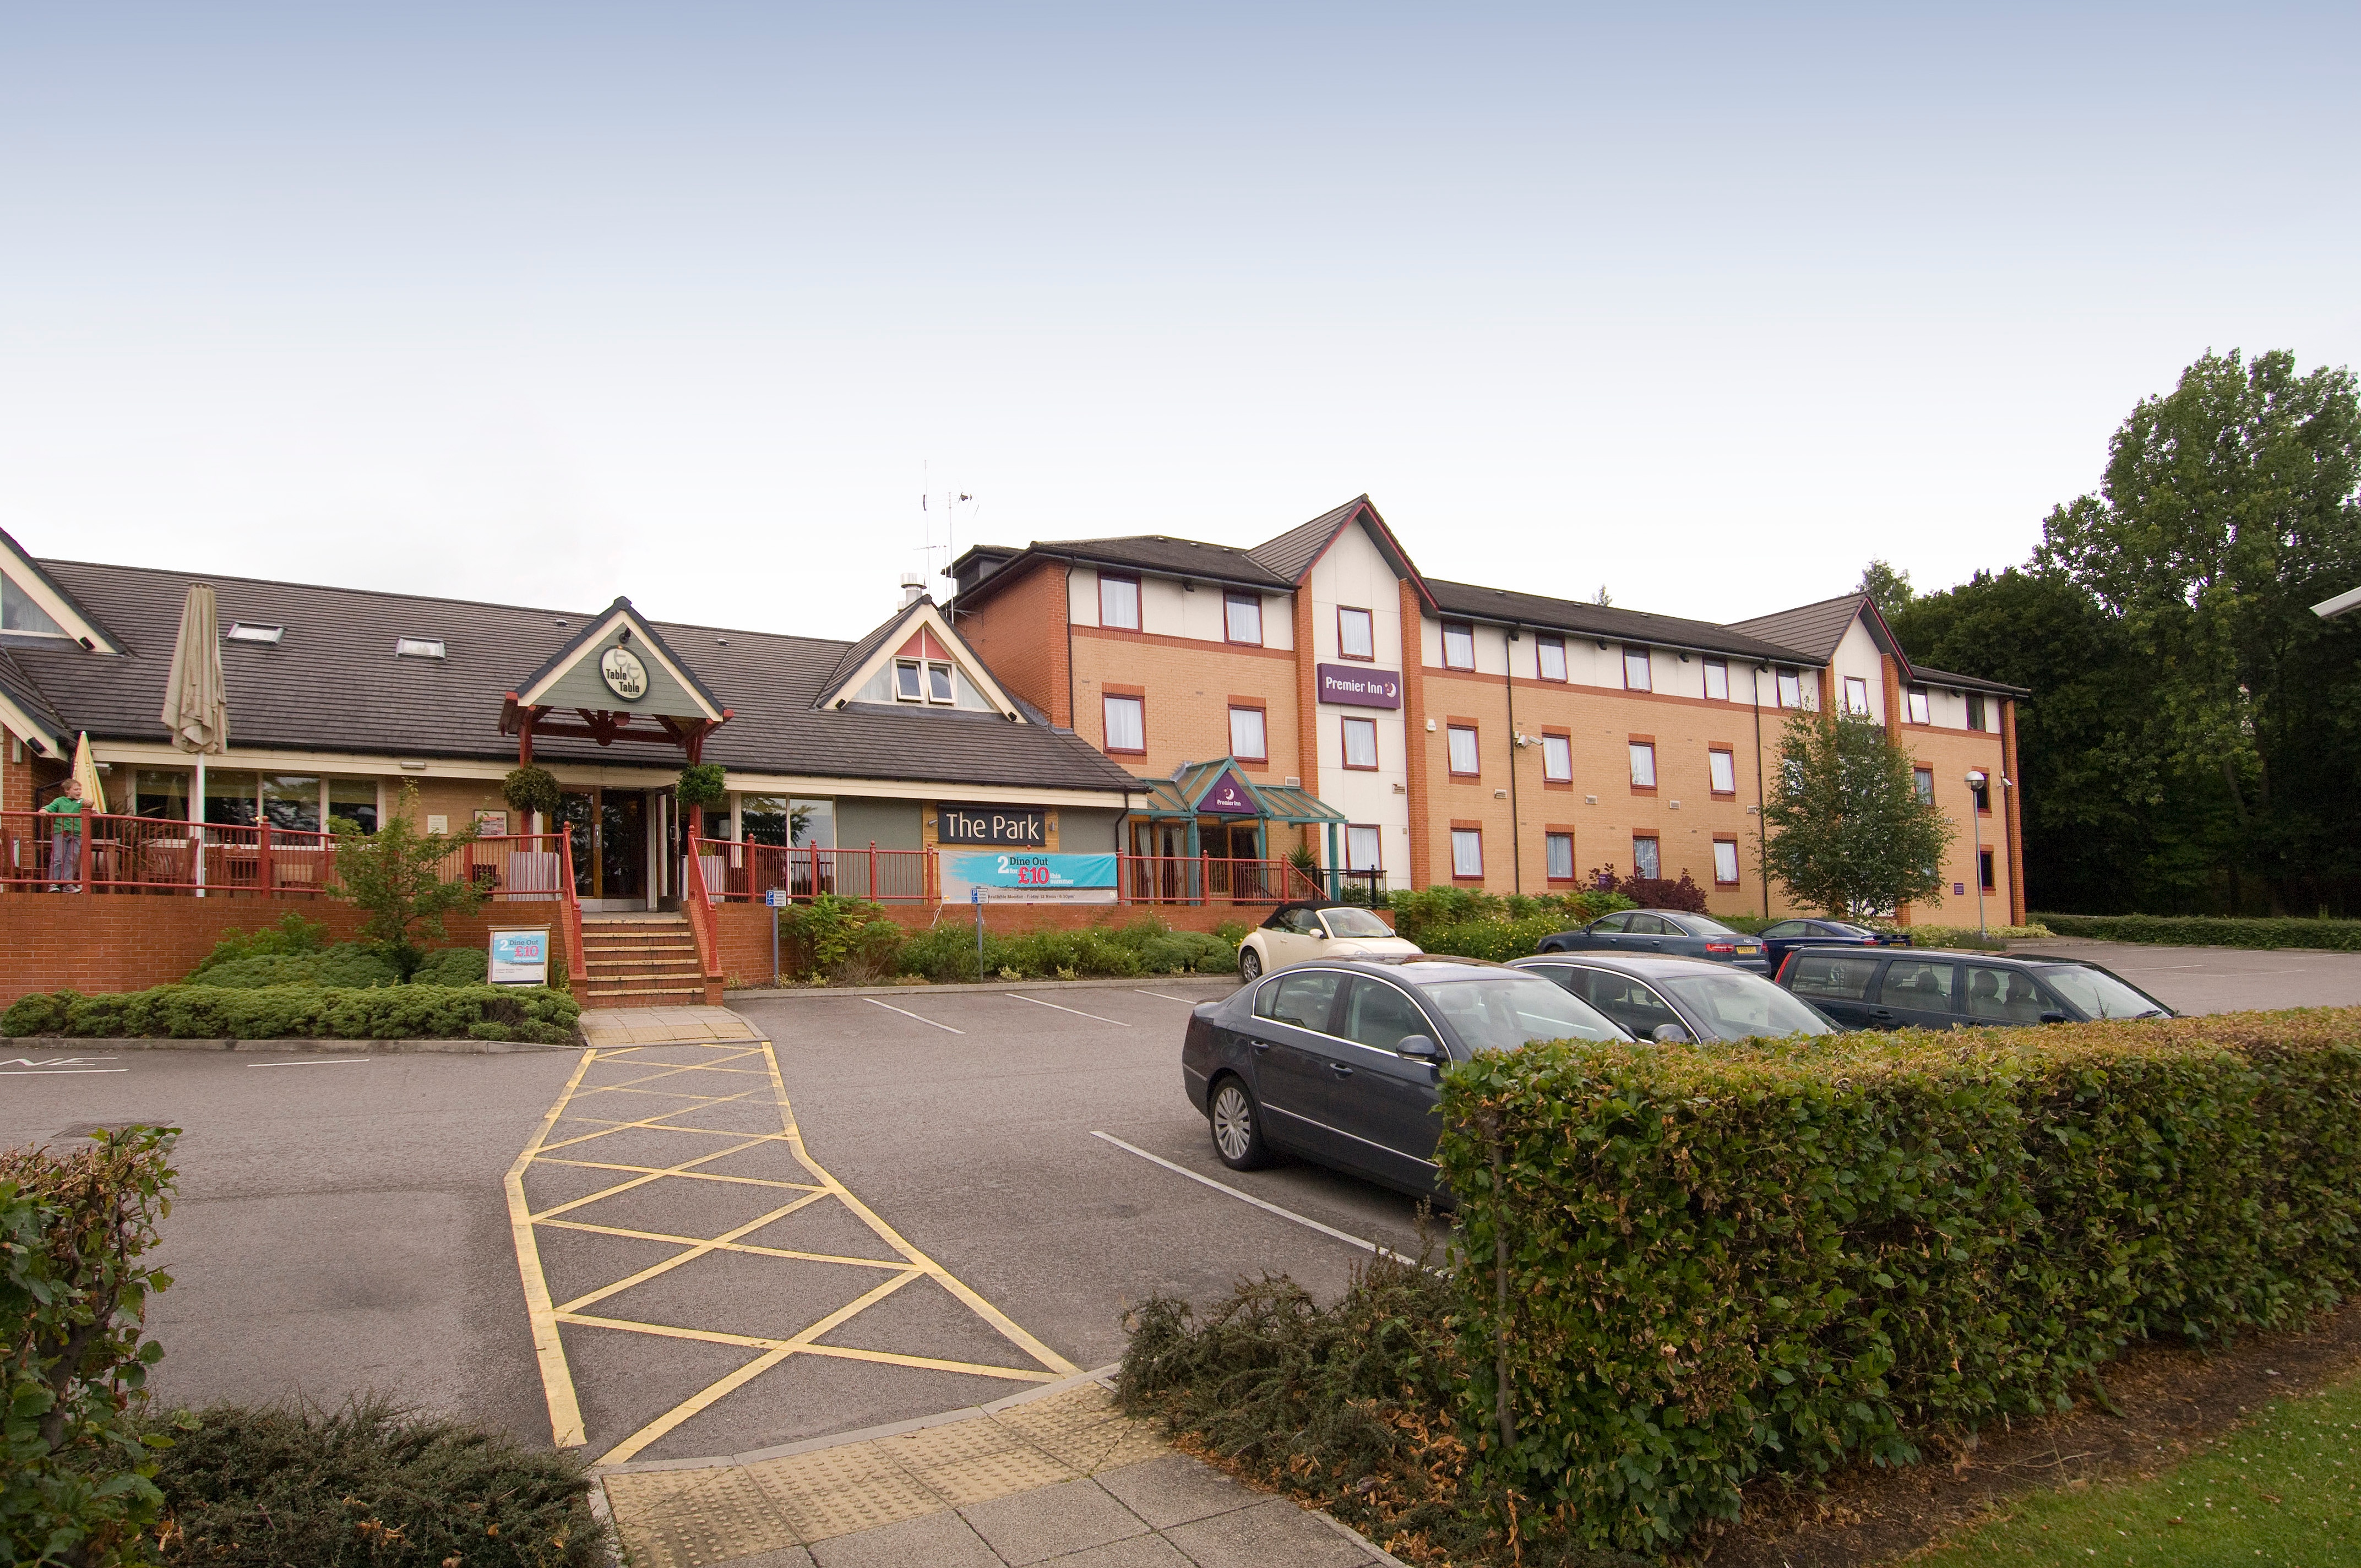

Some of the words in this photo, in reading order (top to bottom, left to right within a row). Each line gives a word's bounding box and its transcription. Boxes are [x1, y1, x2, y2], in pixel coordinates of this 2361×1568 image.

[606, 667, 627, 680] Table
[619, 679, 639, 693] Table
[1326, 676, 1365, 693] Premier
[1368, 681, 1383, 694] Inn
[946, 812, 986, 838] The
[993, 814, 1039, 840] Park
[998, 856, 1009, 874] 2
[1010, 857, 1030, 865] Dine
[1032, 857, 1048, 865] Out
[1018, 867, 1049, 884] £10
[499, 940, 508, 951] 2
[514, 945, 539, 957] £10
